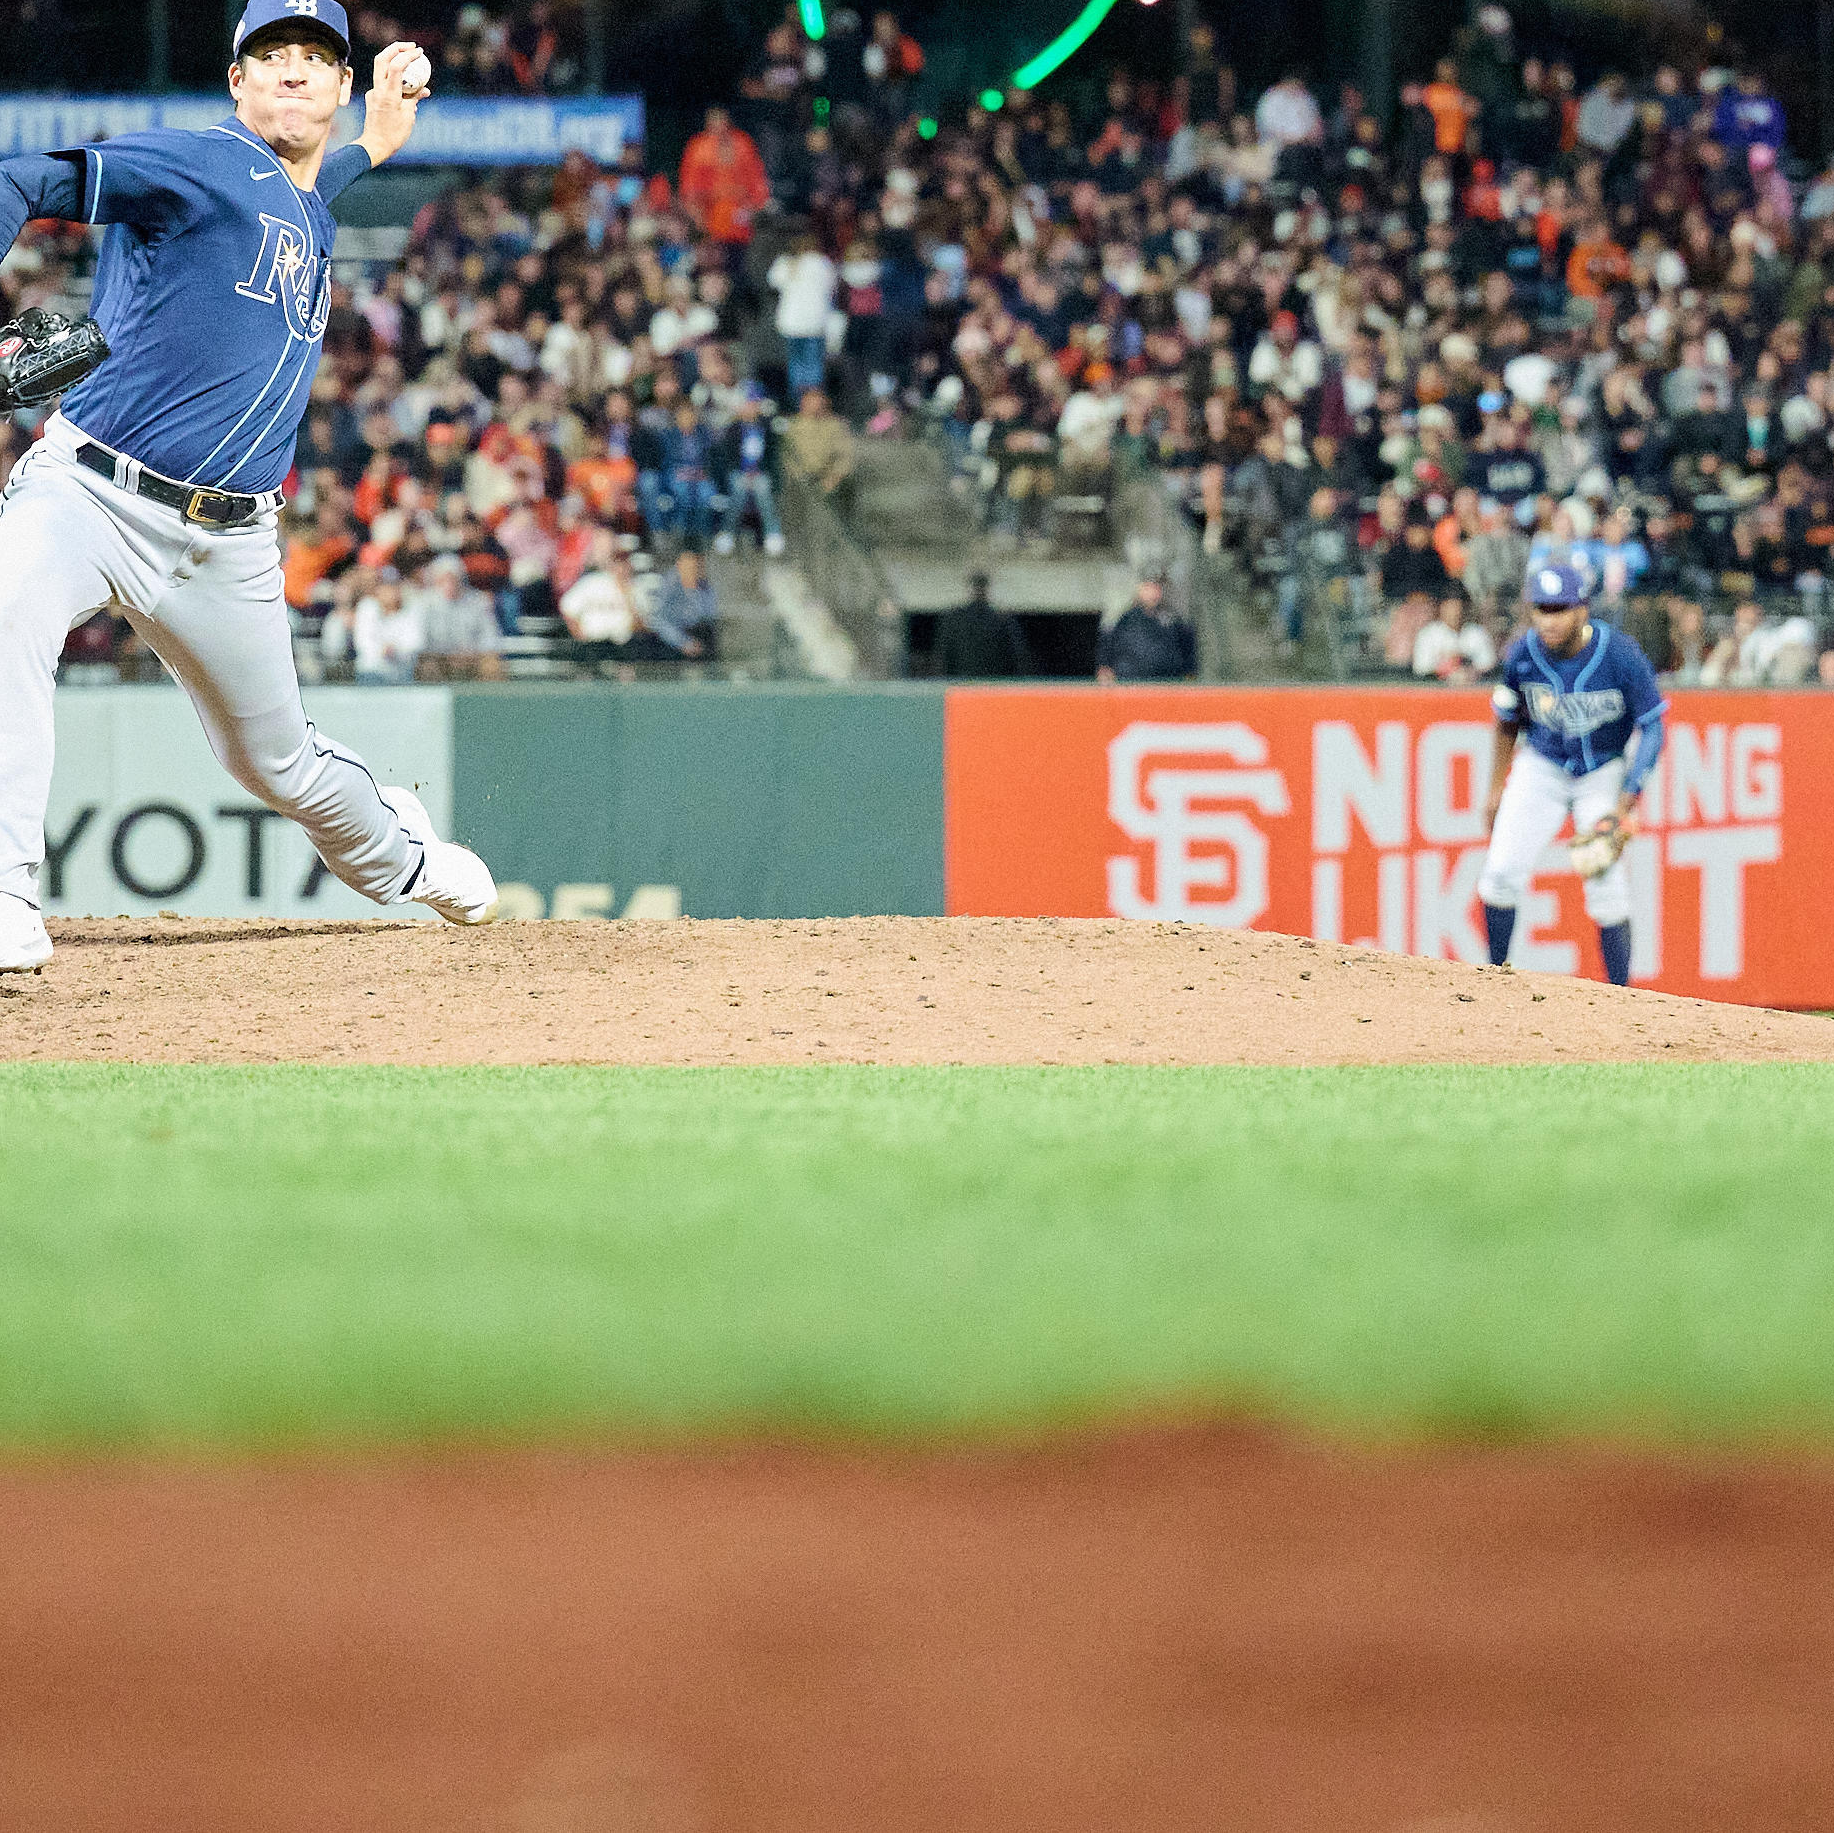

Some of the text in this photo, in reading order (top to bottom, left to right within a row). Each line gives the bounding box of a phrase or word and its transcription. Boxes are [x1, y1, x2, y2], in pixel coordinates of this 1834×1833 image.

[1105, 720, 1291, 929] SF
[1311, 720, 1784, 855] NOING
[1629, 823, 1784, 980] IT
